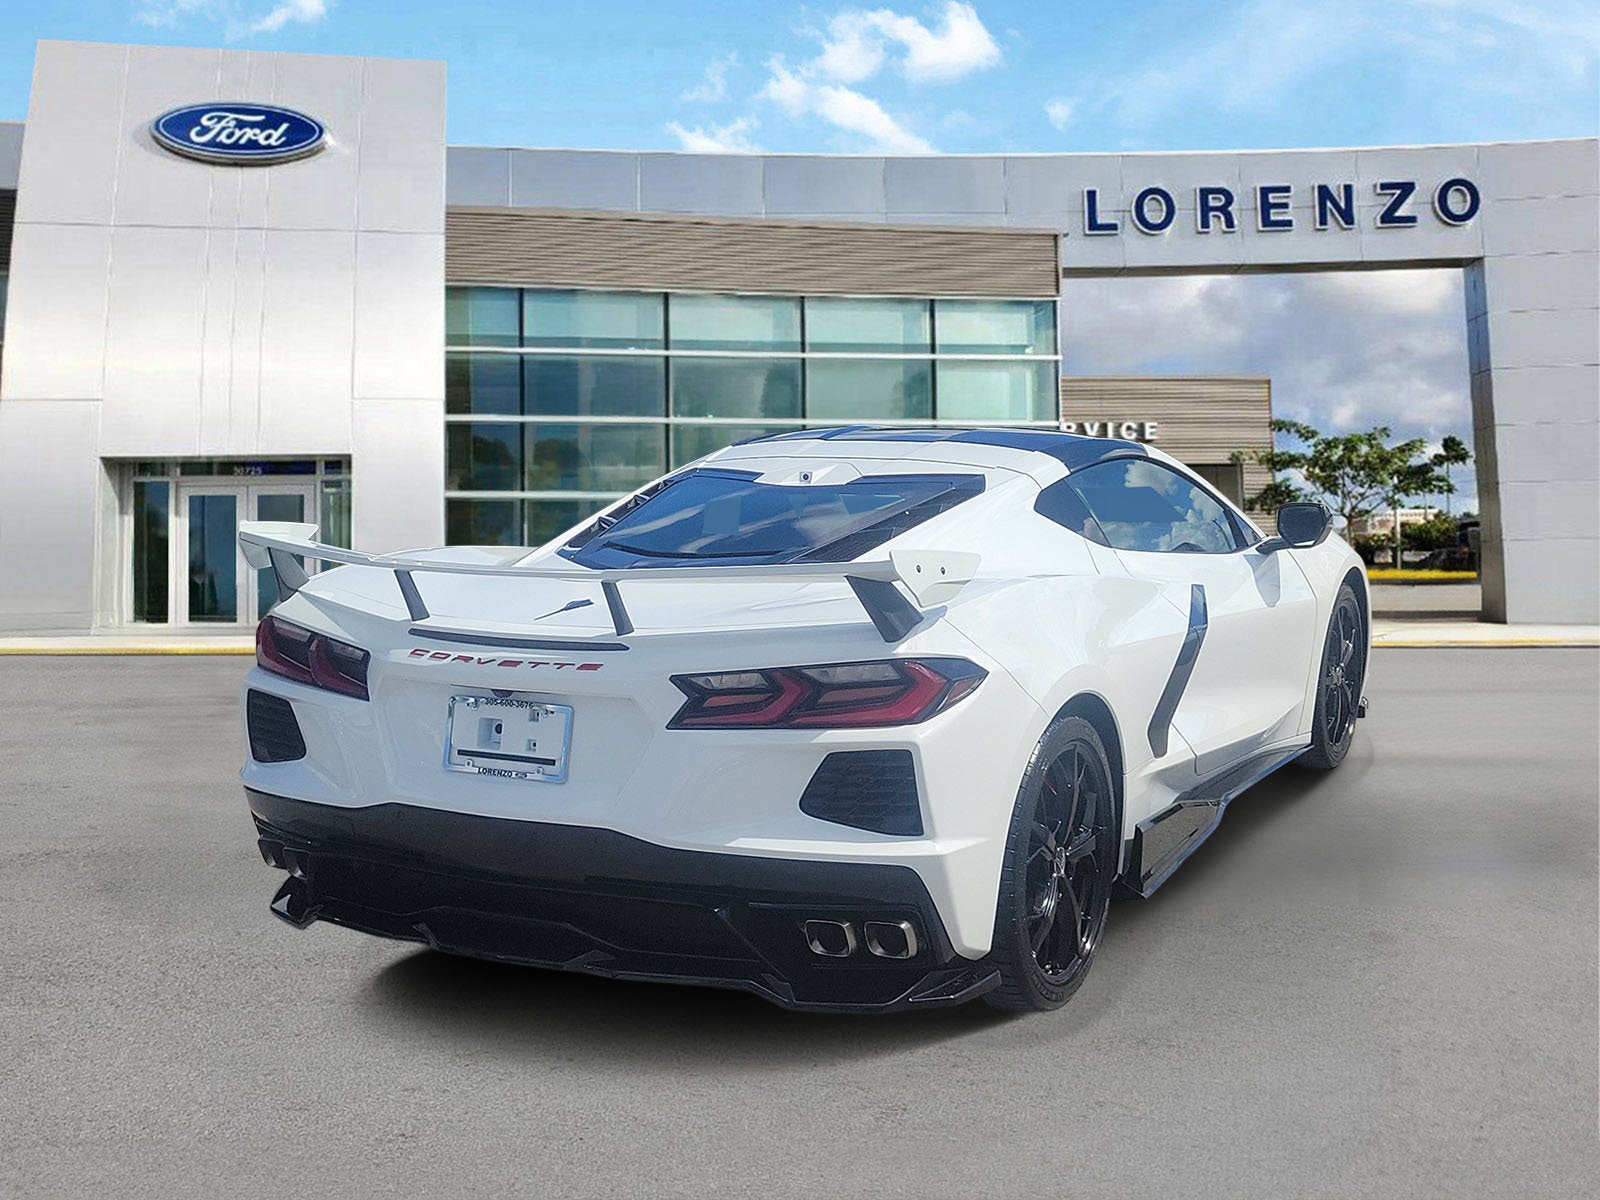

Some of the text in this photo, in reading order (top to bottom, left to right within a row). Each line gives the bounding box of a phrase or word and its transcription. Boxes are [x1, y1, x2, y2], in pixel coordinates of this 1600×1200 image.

[190, 111, 290, 147] Ford
[1081, 178, 1482, 235] LORENZO
[1061, 421, 1159, 440] RVICE
[409, 648, 604, 672] CORVETTE
[484, 697, 534, 710] 305-600-3676
[477, 767, 513, 778] LORENZO
